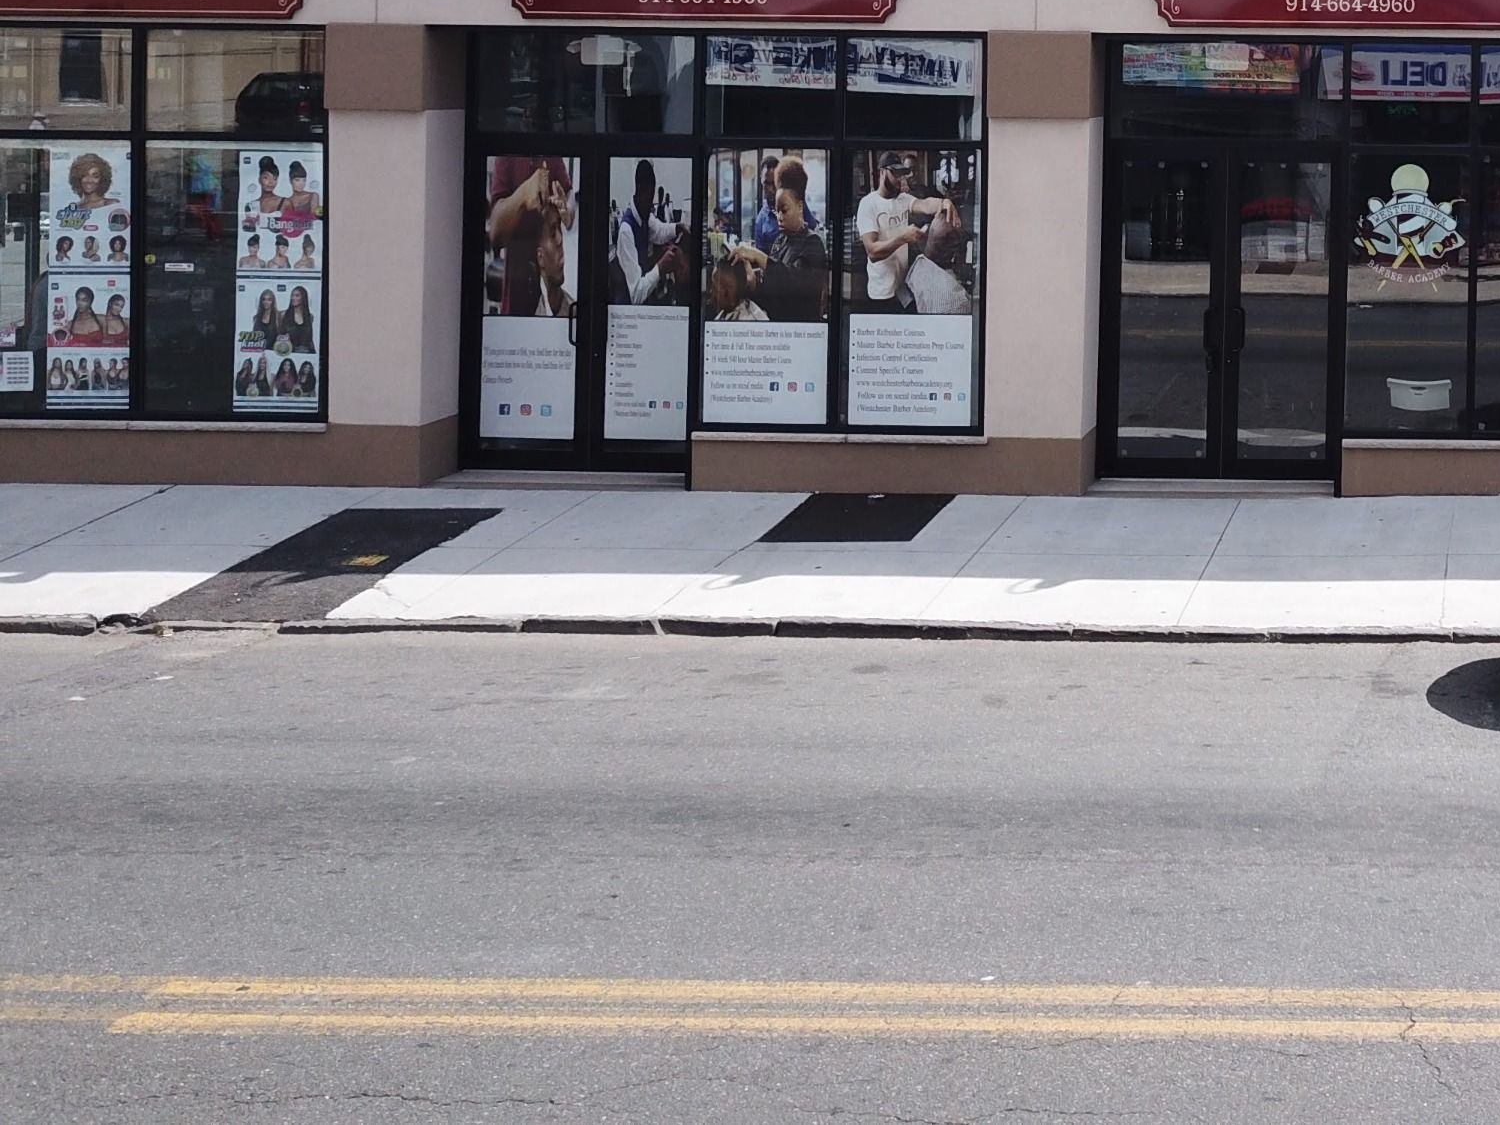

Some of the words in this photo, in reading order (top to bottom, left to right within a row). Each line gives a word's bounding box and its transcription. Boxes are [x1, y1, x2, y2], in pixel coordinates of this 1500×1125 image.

[1372, 203, 1448, 227] WESTCHESTER
[1367, 259, 1403, 283] BARBER
[1408, 260, 1451, 284] ACADEMY
